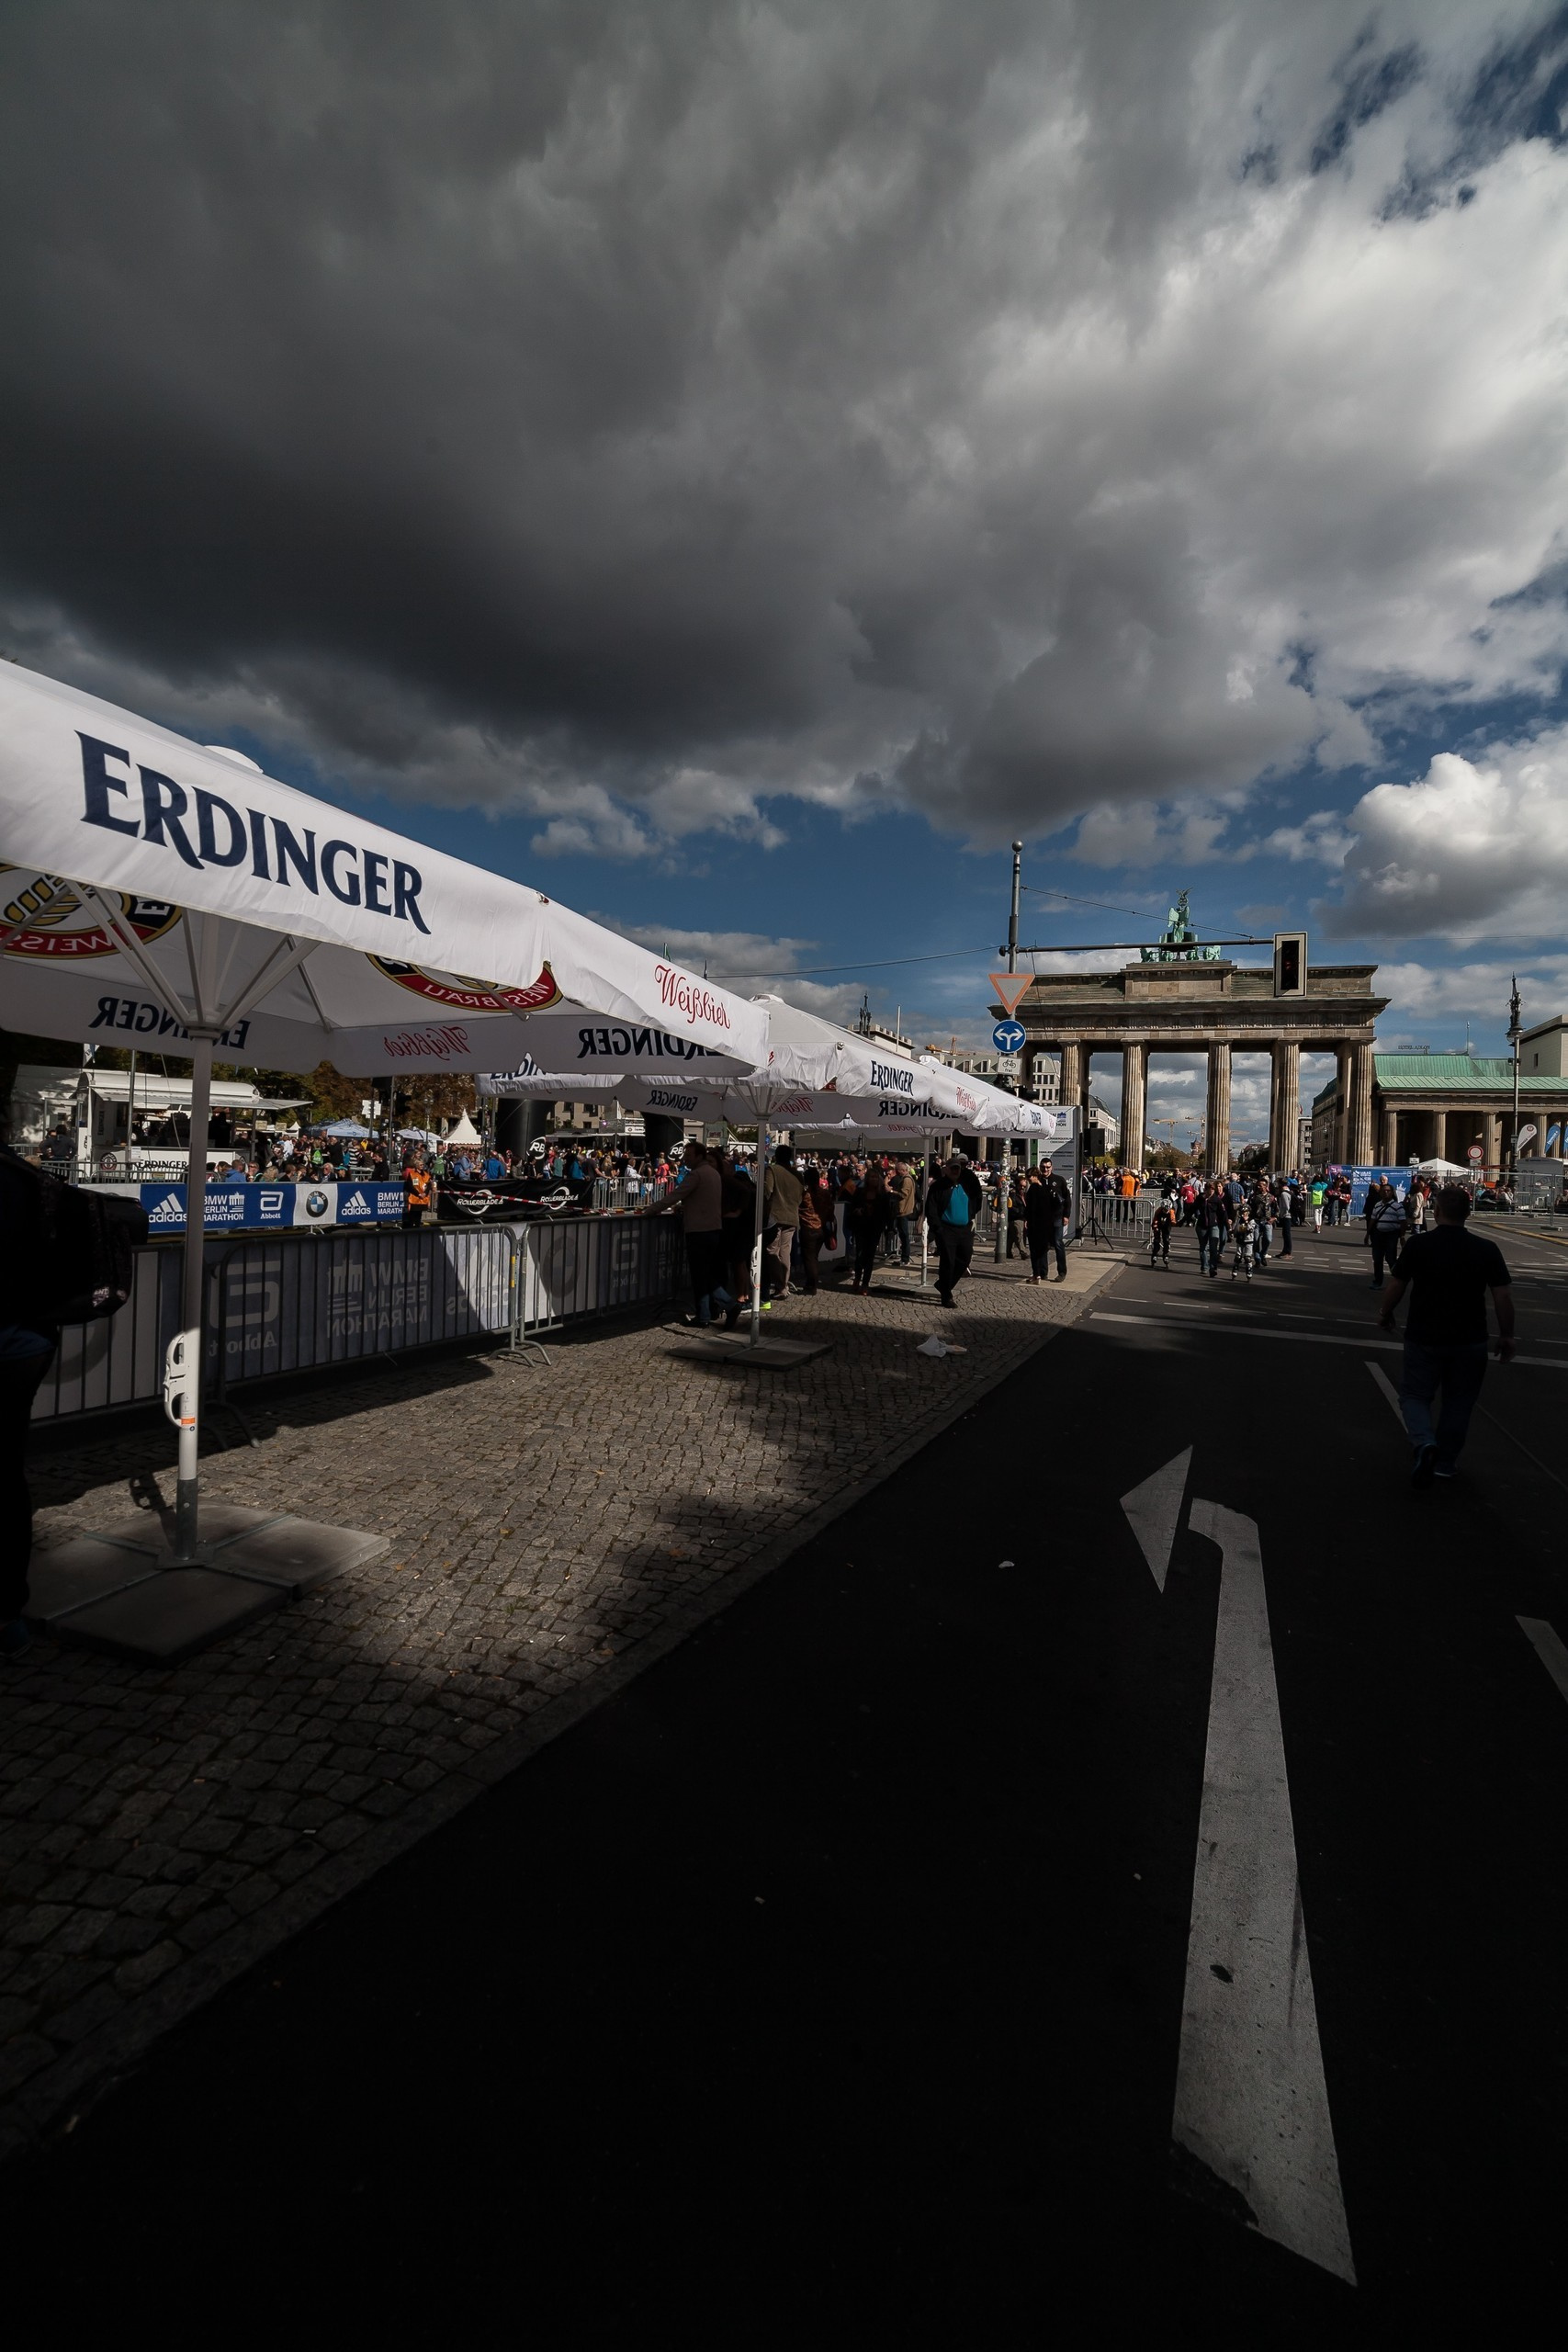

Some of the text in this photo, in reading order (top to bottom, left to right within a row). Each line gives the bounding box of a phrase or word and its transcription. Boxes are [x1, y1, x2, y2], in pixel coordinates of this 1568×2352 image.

[74, 730, 431, 935] ERDINGER
[653, 965, 731, 1030] Weißbier
[870, 1060, 914, 1097] ERDINGER
[378, 1192, 399, 1201] BMW
[149, 1212, 187, 1223] adidas
[342, 1206, 371, 1216] adidas
